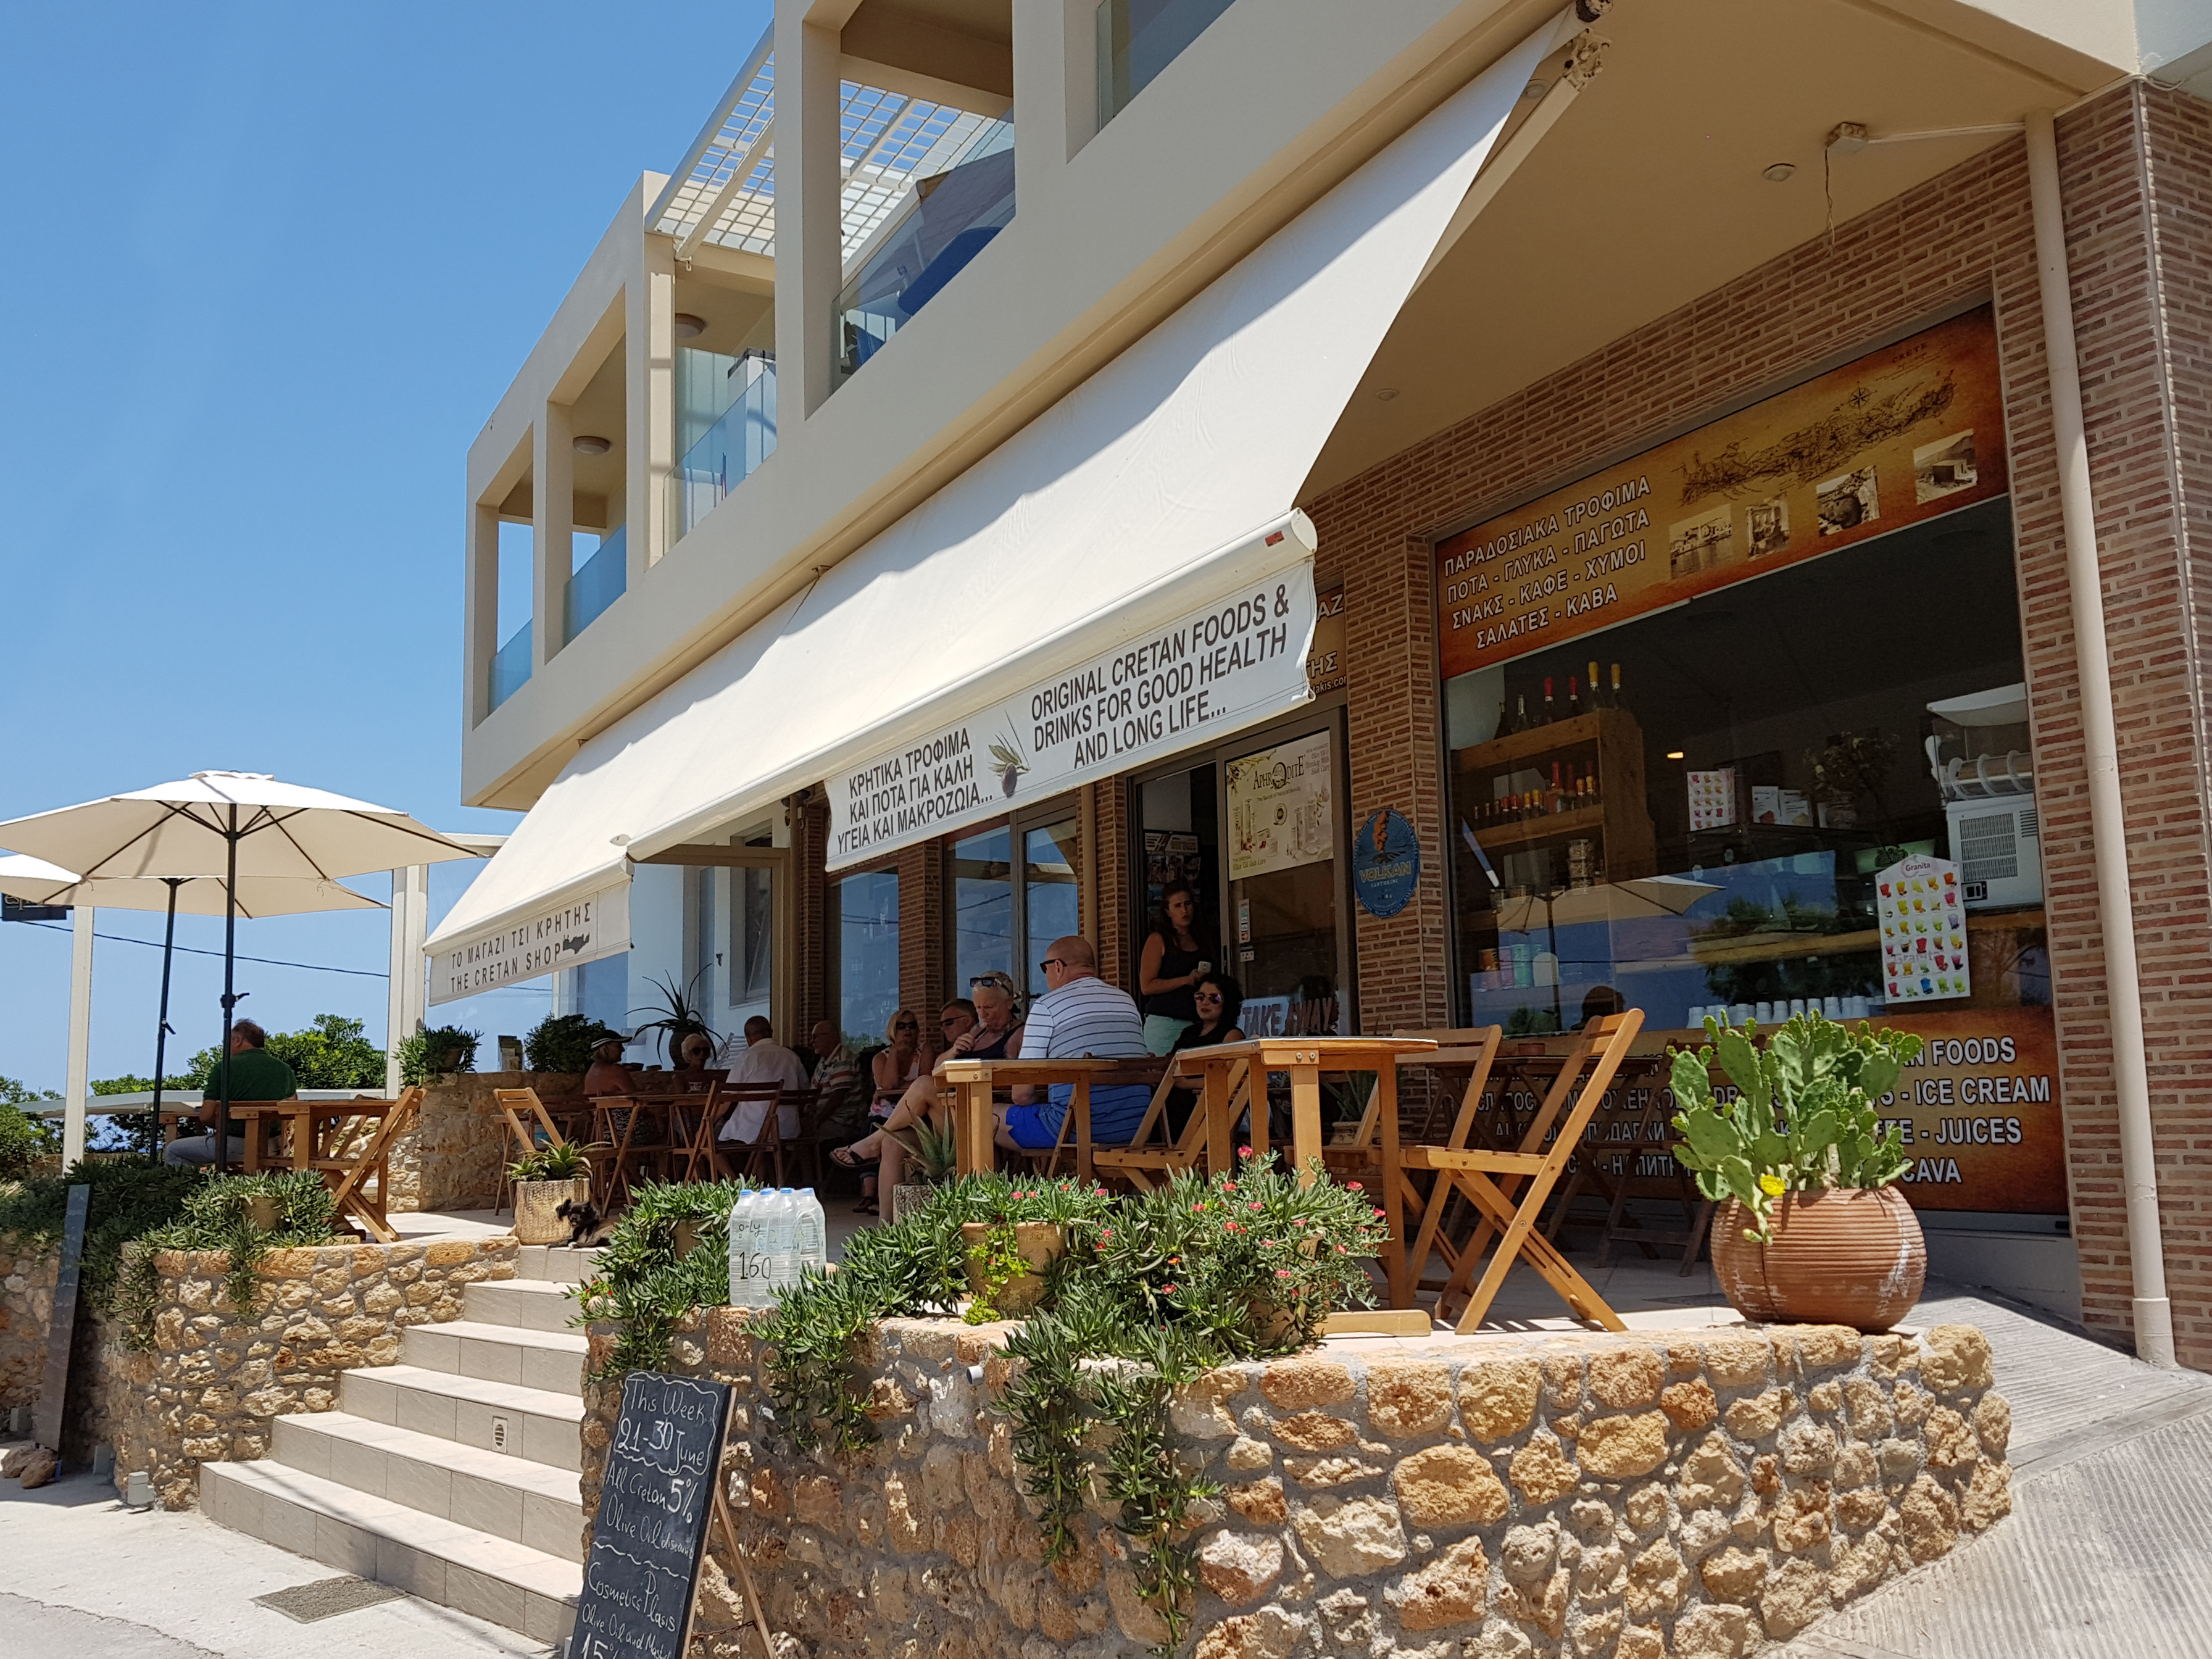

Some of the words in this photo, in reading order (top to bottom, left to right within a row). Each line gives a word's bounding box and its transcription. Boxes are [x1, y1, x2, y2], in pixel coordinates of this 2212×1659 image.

[1445, 515, 1559, 578] ΠΑΡΑΔΟΣΙΑΚΑ
[1564, 476, 1651, 527] ΤΡΟΦΙΜΑ
[1447, 572, 1489, 604] ΠΟΤΑ
[1504, 546, 1557, 582] ΓΛΥΚΑ
[1574, 508, 1650, 554] ΠΑΓΩΤΑ
[1452, 595, 1503, 630] ΣΝΑΚΣ
[1520, 570, 1568, 605] ΚΑΦΕ
[1586, 540, 1646, 581] ΧΥΜΟΙ
[1476, 607, 1549, 649] ΣΑΛΑΤΕΣ
[1566, 583, 1618, 618] ΚΑΒΑ
[1031, 667, 1107, 721] ORIGINAL
[1112, 629, 1186, 686] CRETAN
[1192, 594, 1266, 653] FOODS
[1274, 584, 1289, 617] &
[1034, 704, 1092, 752] DRINKS
[1098, 688, 1131, 722] FOR
[1137, 662, 1194, 709] GOOD
[1200, 623, 1286, 685] HEALTH
[849, 758, 903, 799] ΚΡΗΤΙΚΑ
[905, 728, 971, 775] ΤΡΟΦΙΜΑ
[1075, 733, 1108, 769] AND
[1115, 710, 1163, 755] LONG
[850, 802, 869, 825] ΚΑΙ
[873, 785, 906, 816] ΠΟΤΑ
[909, 775, 931, 802] ΓΙΑ
[934, 754, 973, 792] ΚΑΛΗ
[838, 826, 870, 854] ΥΓΕΙΑ
[873, 816, 894, 840] ΚΑΙ
[1358, 860, 1412, 883] VOLKAN
[1905, 862, 1931, 871] Granita
[452, 952, 462, 969] ΤΟ
[468, 935, 505, 964] ΜΑΓΑΖΙ
[512, 926, 529, 949] ΤΣΙ
[537, 902, 591, 939] ΚΡΗΤΗΣ
[451, 973, 468, 992] THE
[475, 957, 518, 986] CRETAN
[526, 943, 560, 971] SHOP
[1242, 1004, 1281, 1036] TAKE
[1931, 1036, 2016, 1066] FOODS
[1915, 1078, 1954, 1105] ICE
[1961, 1076, 2050, 1105] CREAM
[1935, 1117, 2023, 1144] JUICES
[739, 1251, 772, 1279] 1.60
[628, 1379, 657, 1413] This
[662, 1386, 706, 1421] Week
[669, 1429, 705, 1476] June
[605, 1461, 625, 1495] All
[630, 1473, 667, 1511] Cretan
[667, 1478, 699, 1524] 5%
[606, 1495, 636, 1539] Olive
[639, 1516, 663, 1551] Oil
[588, 1561, 644, 1612] Cosmetics
[582, 1603, 605, 1633] Olive
[609, 1613, 625, 1643] Oil
[626, 1633, 645, 1650] and
